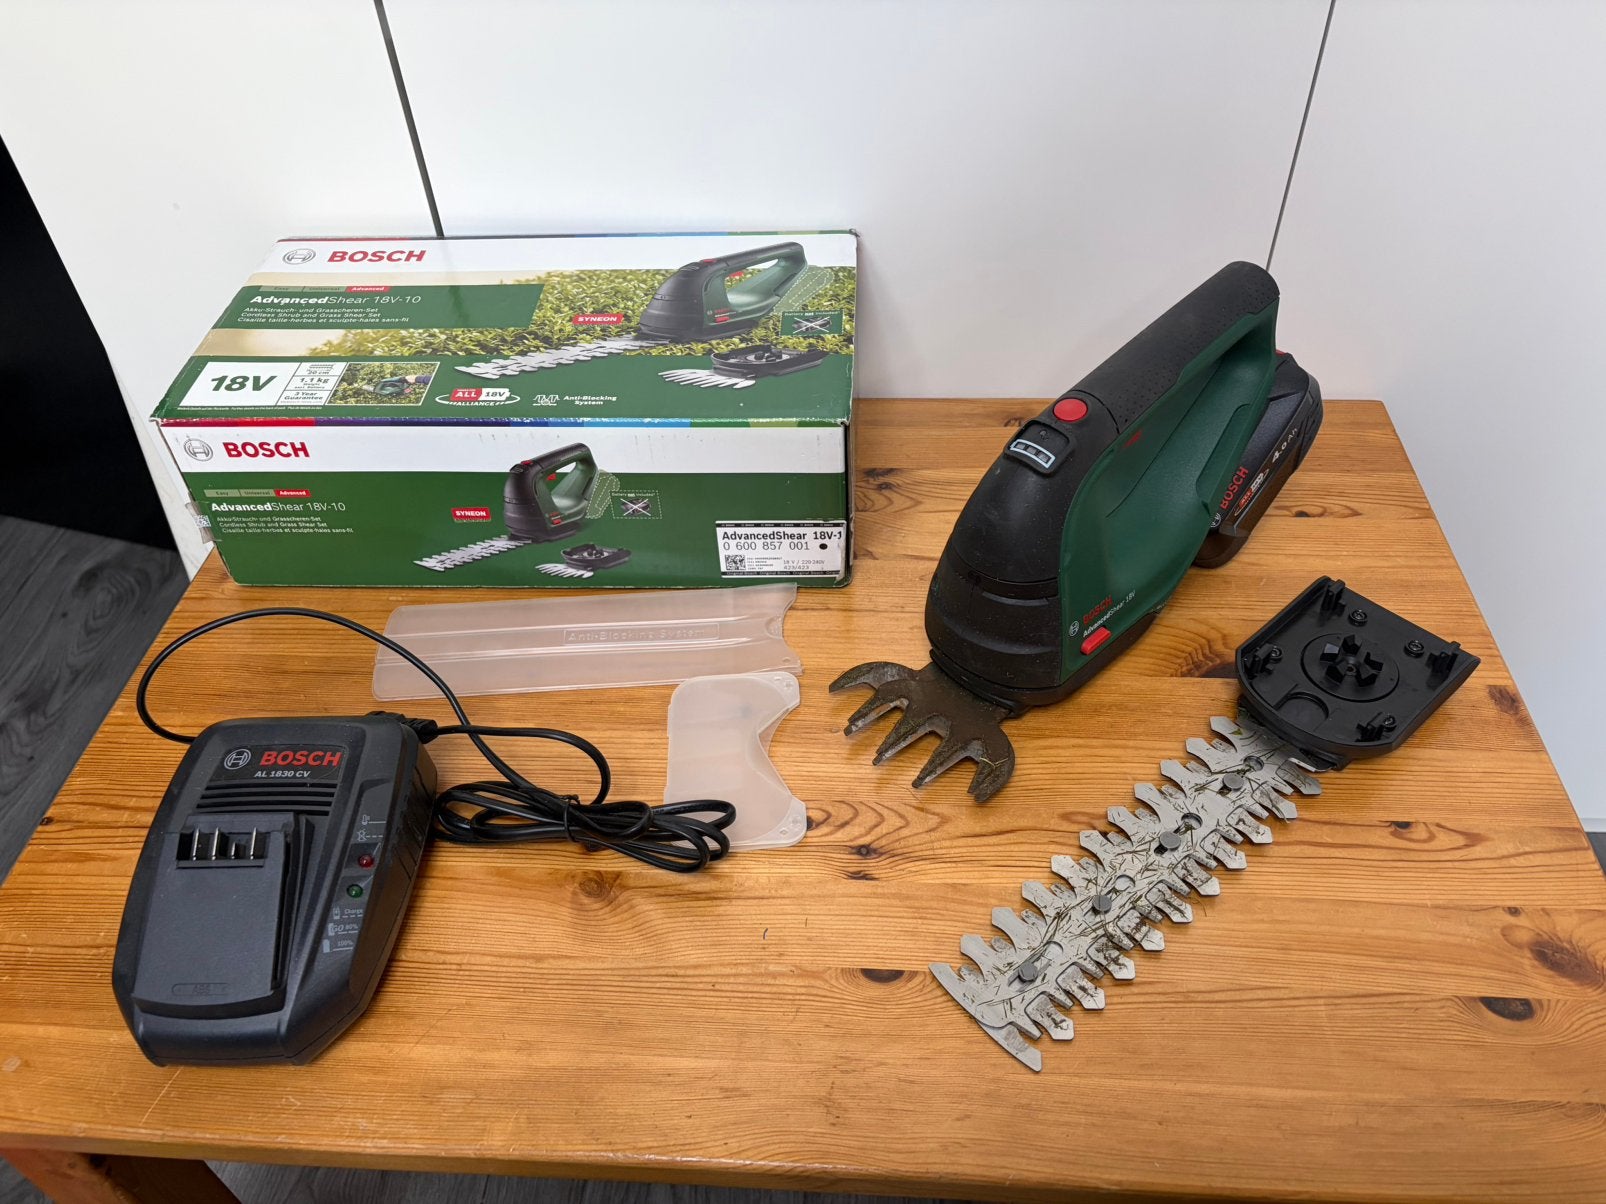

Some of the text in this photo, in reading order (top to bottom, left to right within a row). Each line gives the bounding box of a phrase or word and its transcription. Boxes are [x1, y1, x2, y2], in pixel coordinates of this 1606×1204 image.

[327, 250, 426, 263] BOSCH
[250, 295, 422, 304] AdvancedShear 18V-10
[210, 375, 278, 392] 18V
[222, 441, 311, 459] BOSCH
[1219, 466, 1249, 510] BOSCH
[211, 502, 346, 512] AdvancedShear 18V-10
[722, 530, 807, 540] AdvancedShear
[723, 541, 810, 551] 0 600 857 001
[1083, 594, 1113, 625] BOSCH
[1083, 600, 1125, 637] AdvancedShear
[259, 751, 342, 767] BOSCH
[254, 770, 311, 778] AL 1830 CV
